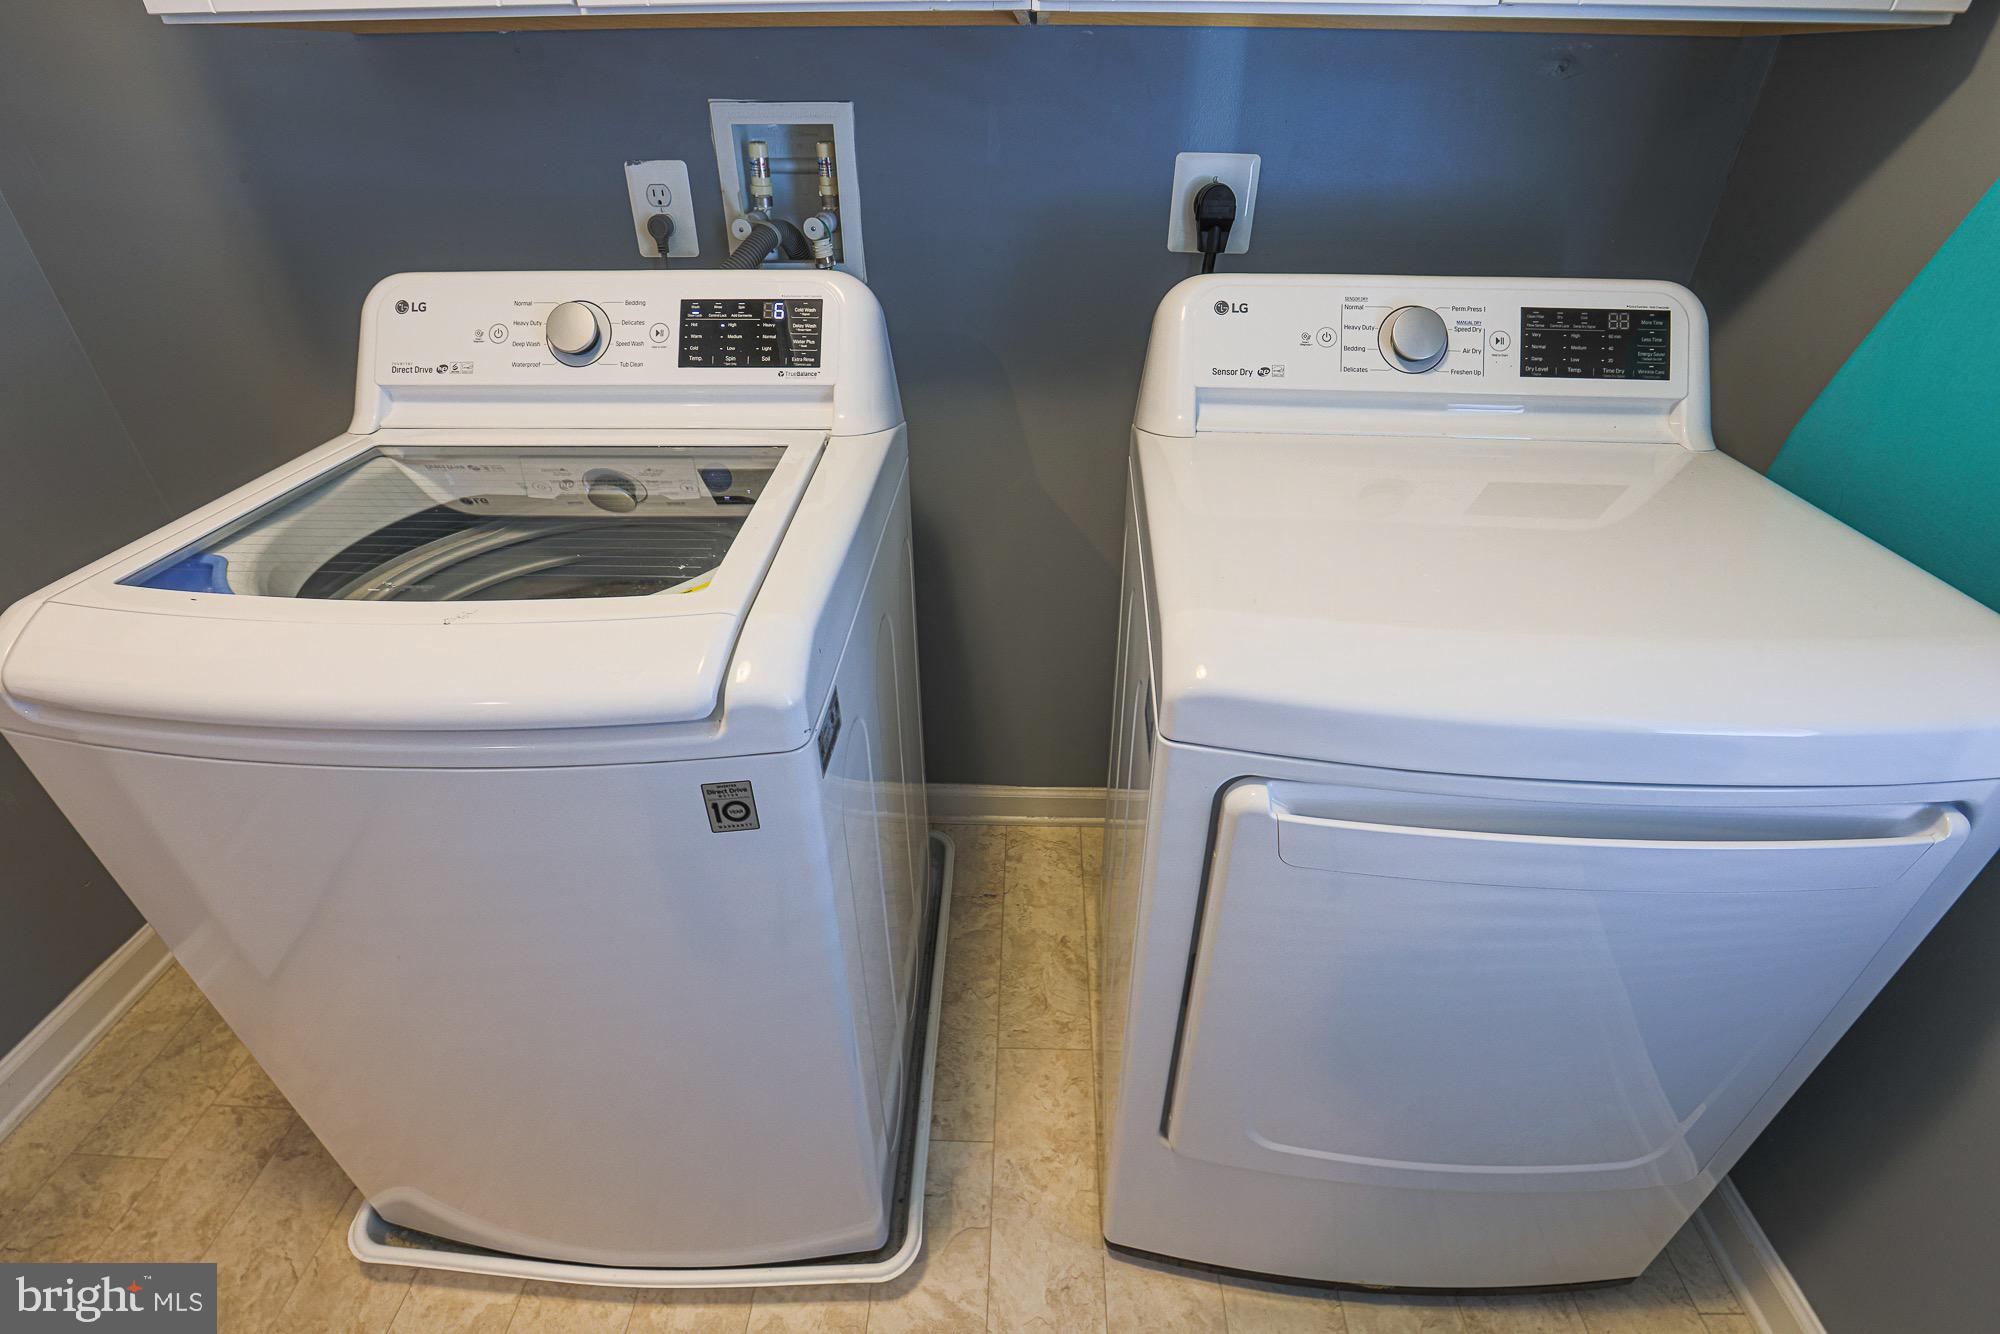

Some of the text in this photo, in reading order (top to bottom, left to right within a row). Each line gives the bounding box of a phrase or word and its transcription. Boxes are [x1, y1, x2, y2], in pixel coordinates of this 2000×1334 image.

[411, 302, 427, 312] LG
[774, 302, 784, 319] 6
[1231, 302, 1249, 313] LG
[616, 340, 631, 348] Speed
[391, 365, 433, 374] Direct Drive
[511, 361, 541, 369] Waterproof
[1212, 367, 1253, 377] Sensor Dry
[1450, 368, 1481, 376] Freshen Up
[711, 801, 751, 823] 10
